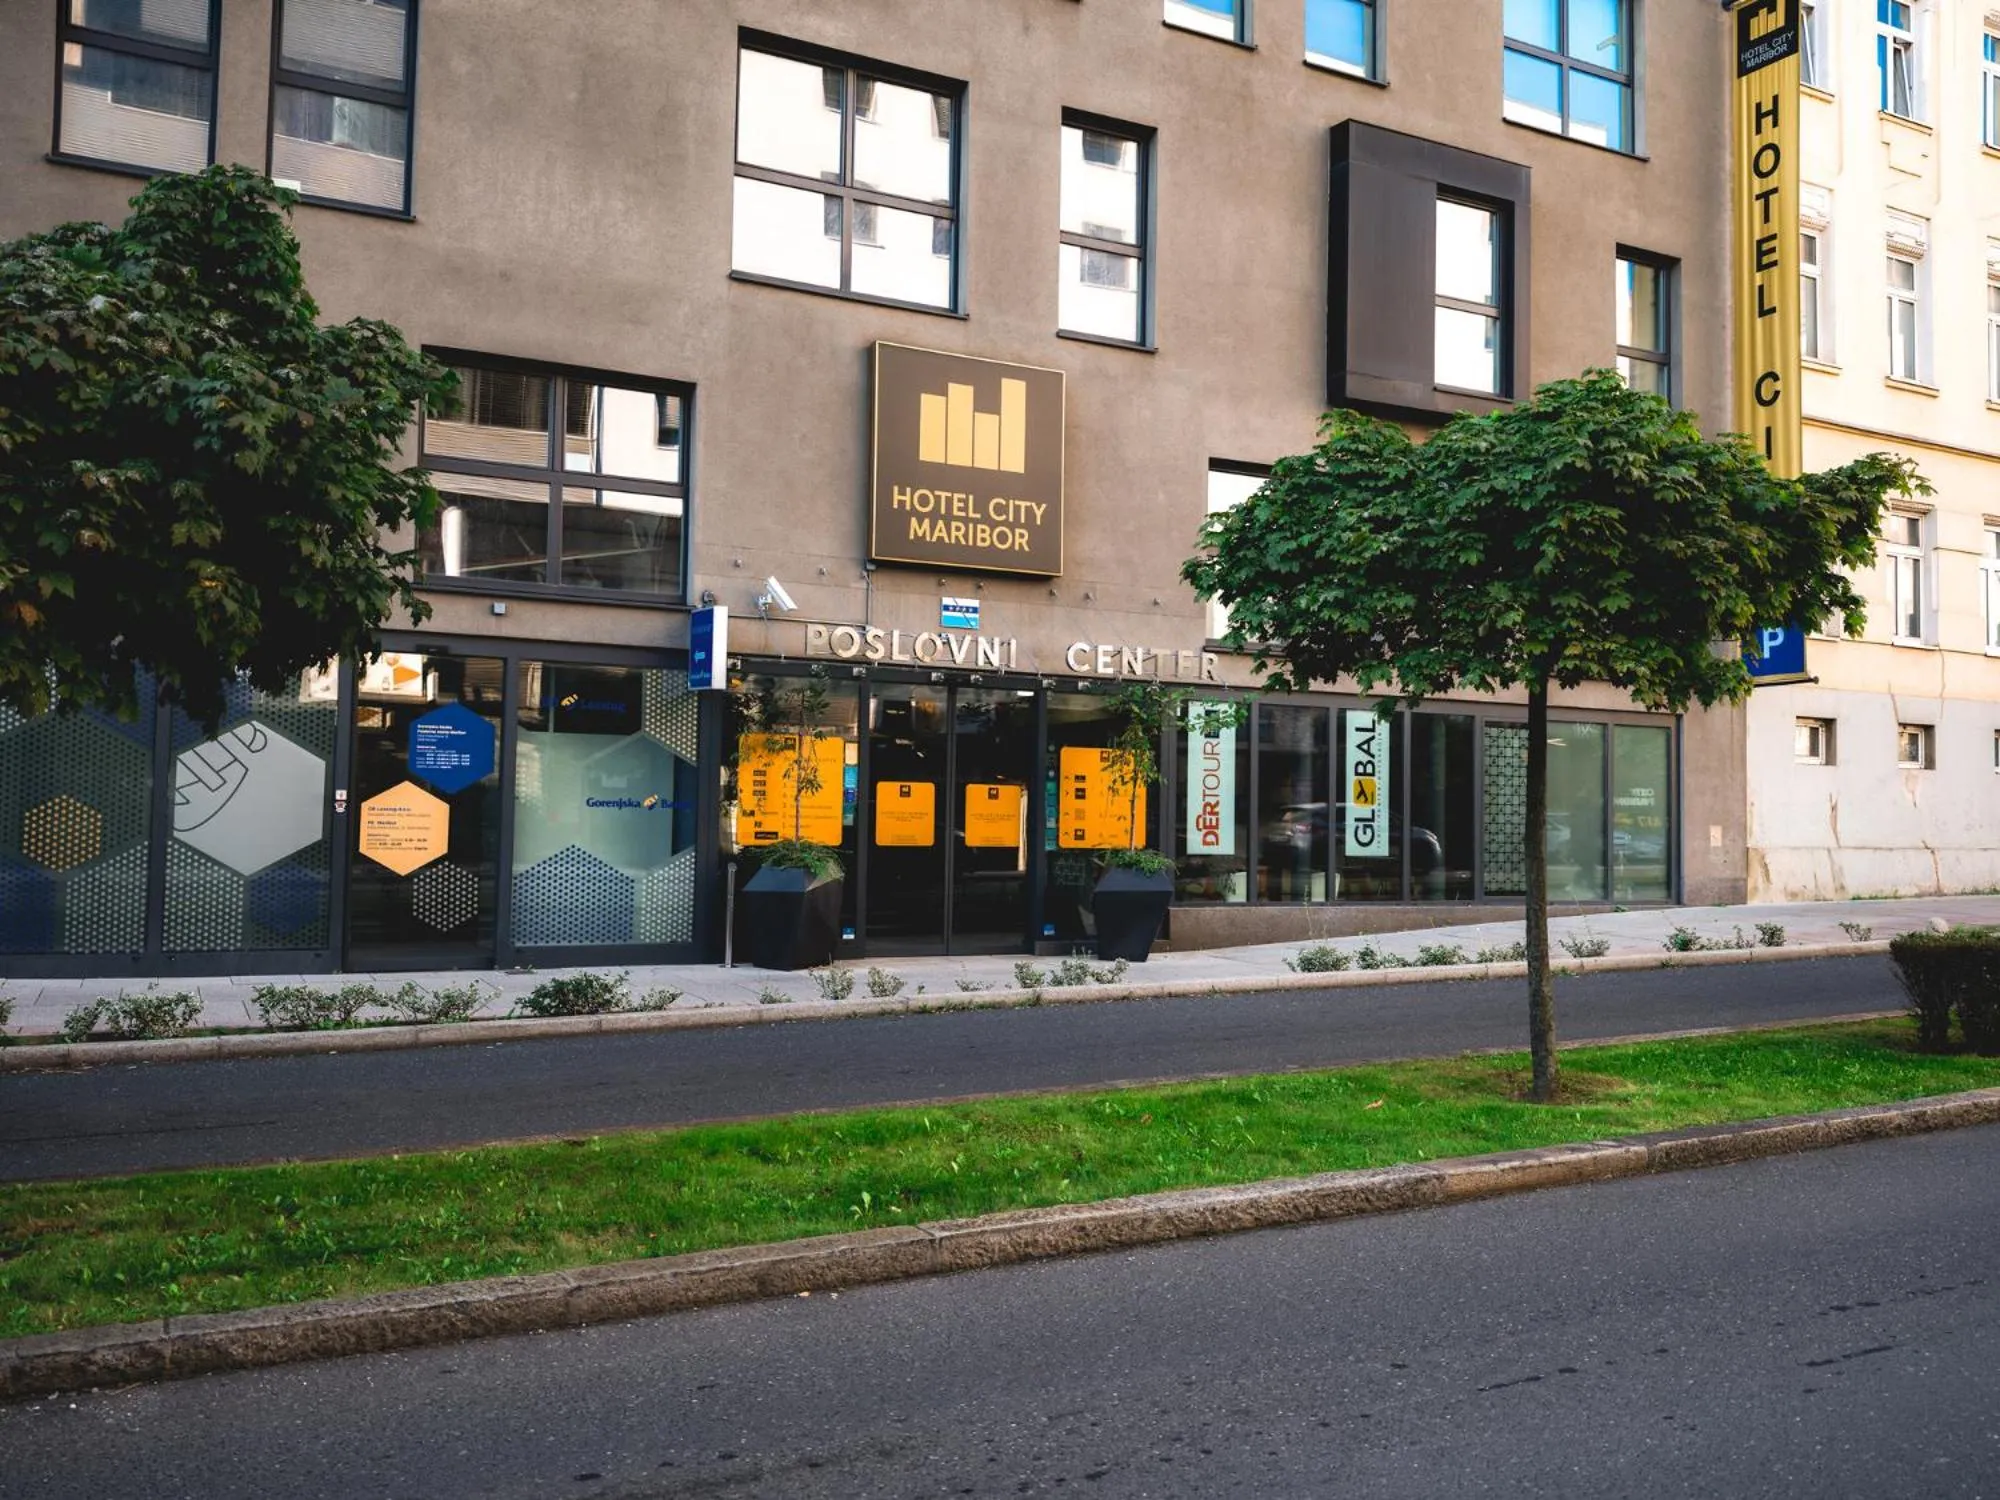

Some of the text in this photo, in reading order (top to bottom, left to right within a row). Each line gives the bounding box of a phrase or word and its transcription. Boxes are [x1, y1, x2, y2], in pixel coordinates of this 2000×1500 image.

[1741, 30, 1794, 61] HOTEL CITY
[1746, 43, 1788, 68] MARIBOR
[1752, 94, 1781, 318] HOTEL
[892, 485, 1048, 525] HOTEL CITY
[909, 516, 1030, 552] MARIBOR
[806, 623, 1219, 681] POSLOVNI CENTER
[1763, 626, 1785, 659] P
[1202, 740, 1221, 847] DERTOUR
[1354, 719, 1377, 848] GLBAL
[586, 797, 641, 810] Gorenjska
